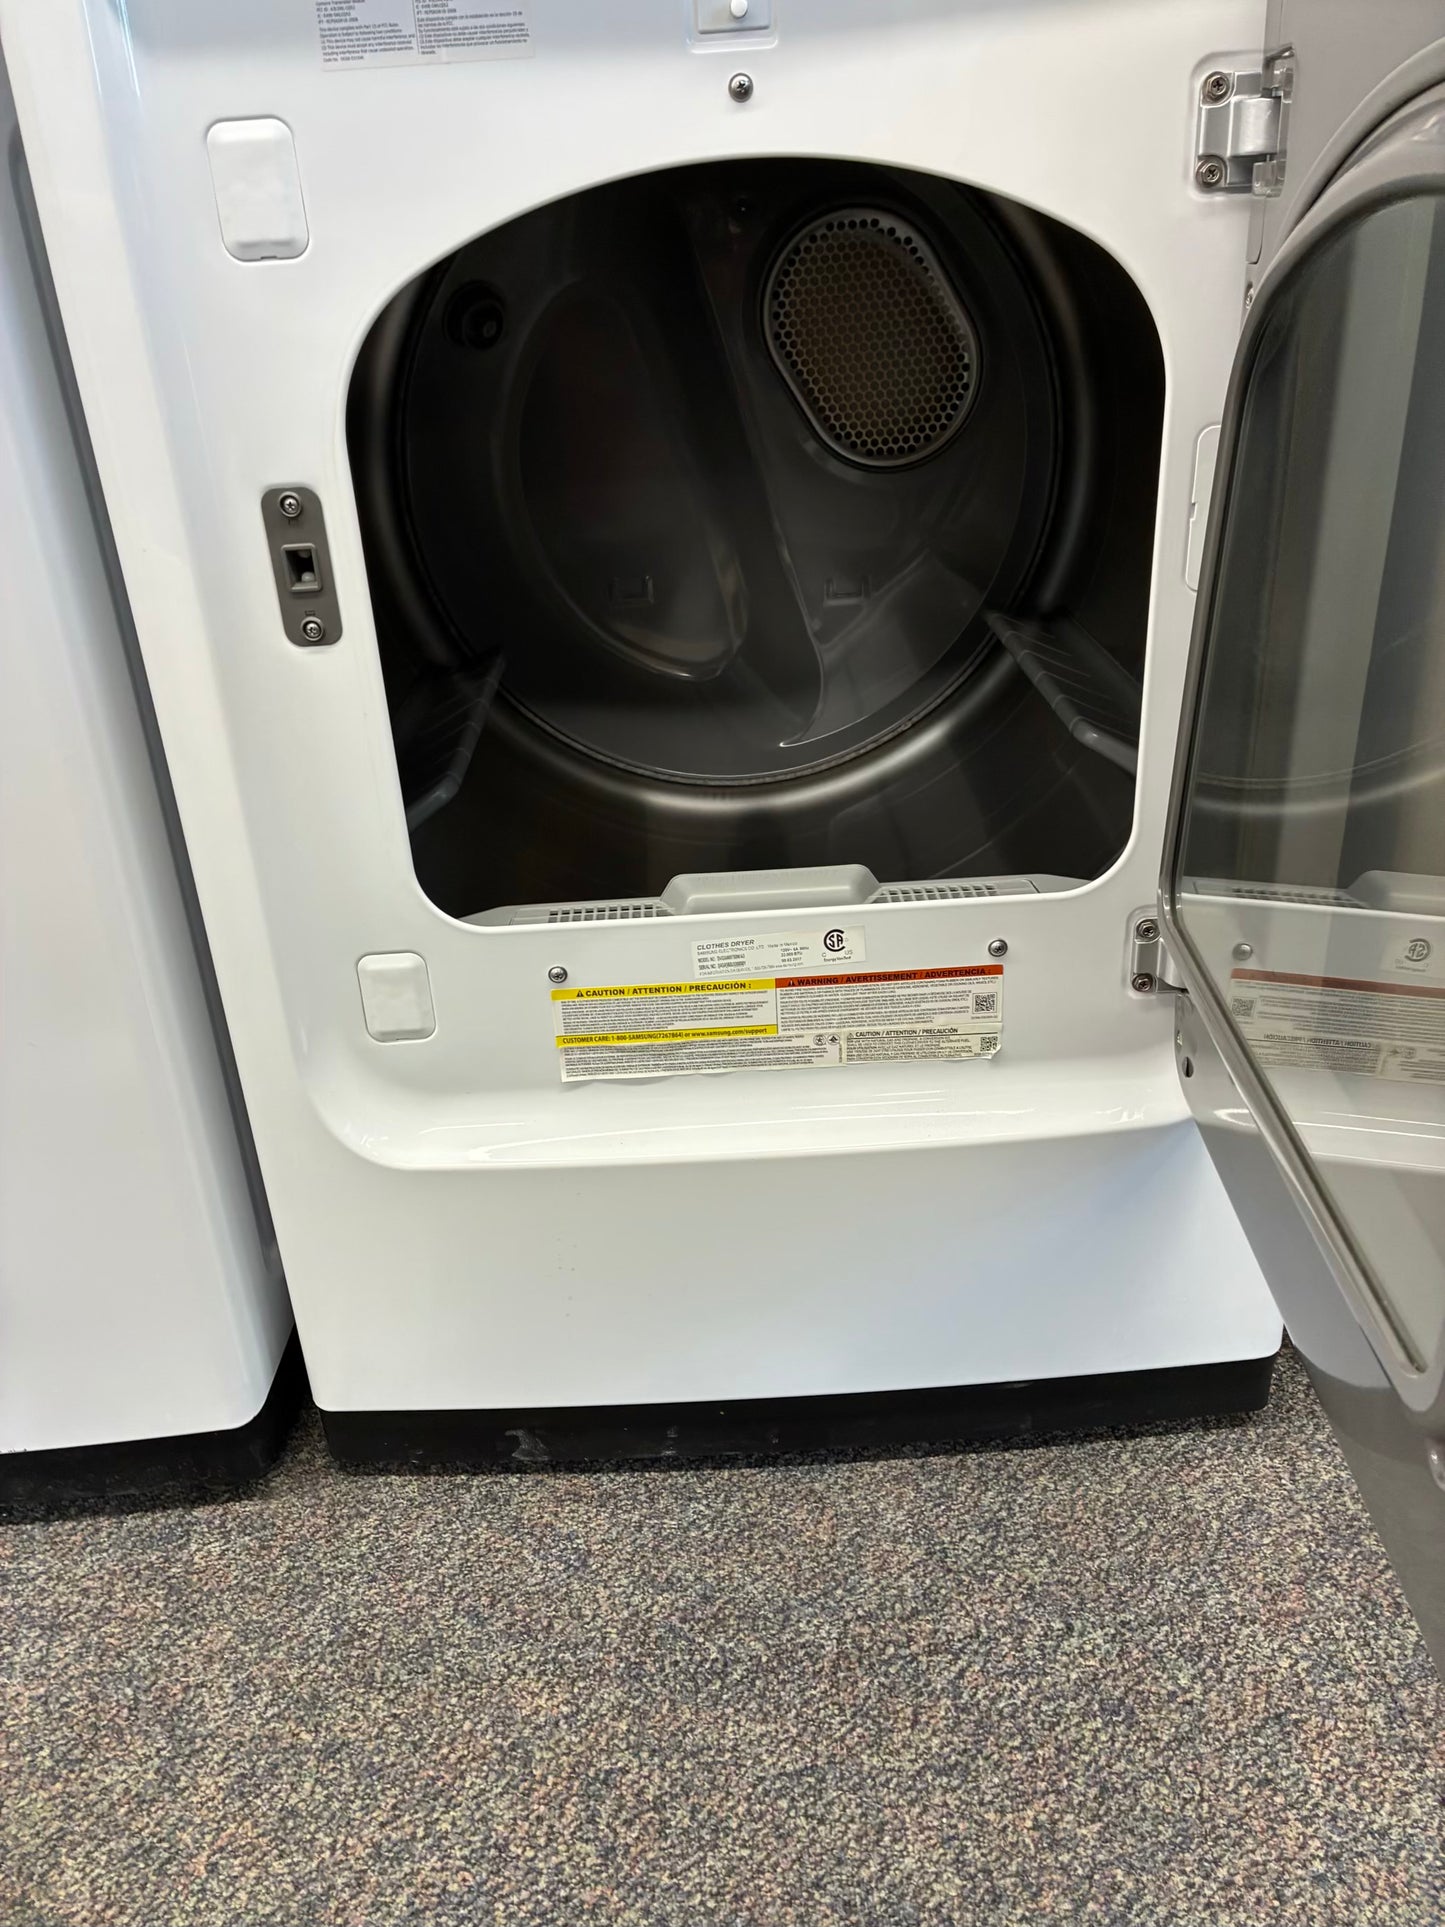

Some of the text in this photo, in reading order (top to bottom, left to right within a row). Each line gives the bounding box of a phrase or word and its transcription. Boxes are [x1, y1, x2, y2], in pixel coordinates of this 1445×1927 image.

[697, 942, 729, 950] CLOTHES
[797, 977, 838, 986] WARNING
[845, 972, 917, 983] AVERTISSEMENT
[924, 968, 986, 979] ADVERTENCIA
[586, 988, 625, 996] CAUTION
[632, 985, 682, 995] ATTENTION
[690, 981, 746, 991] PRECAUCIÓN
